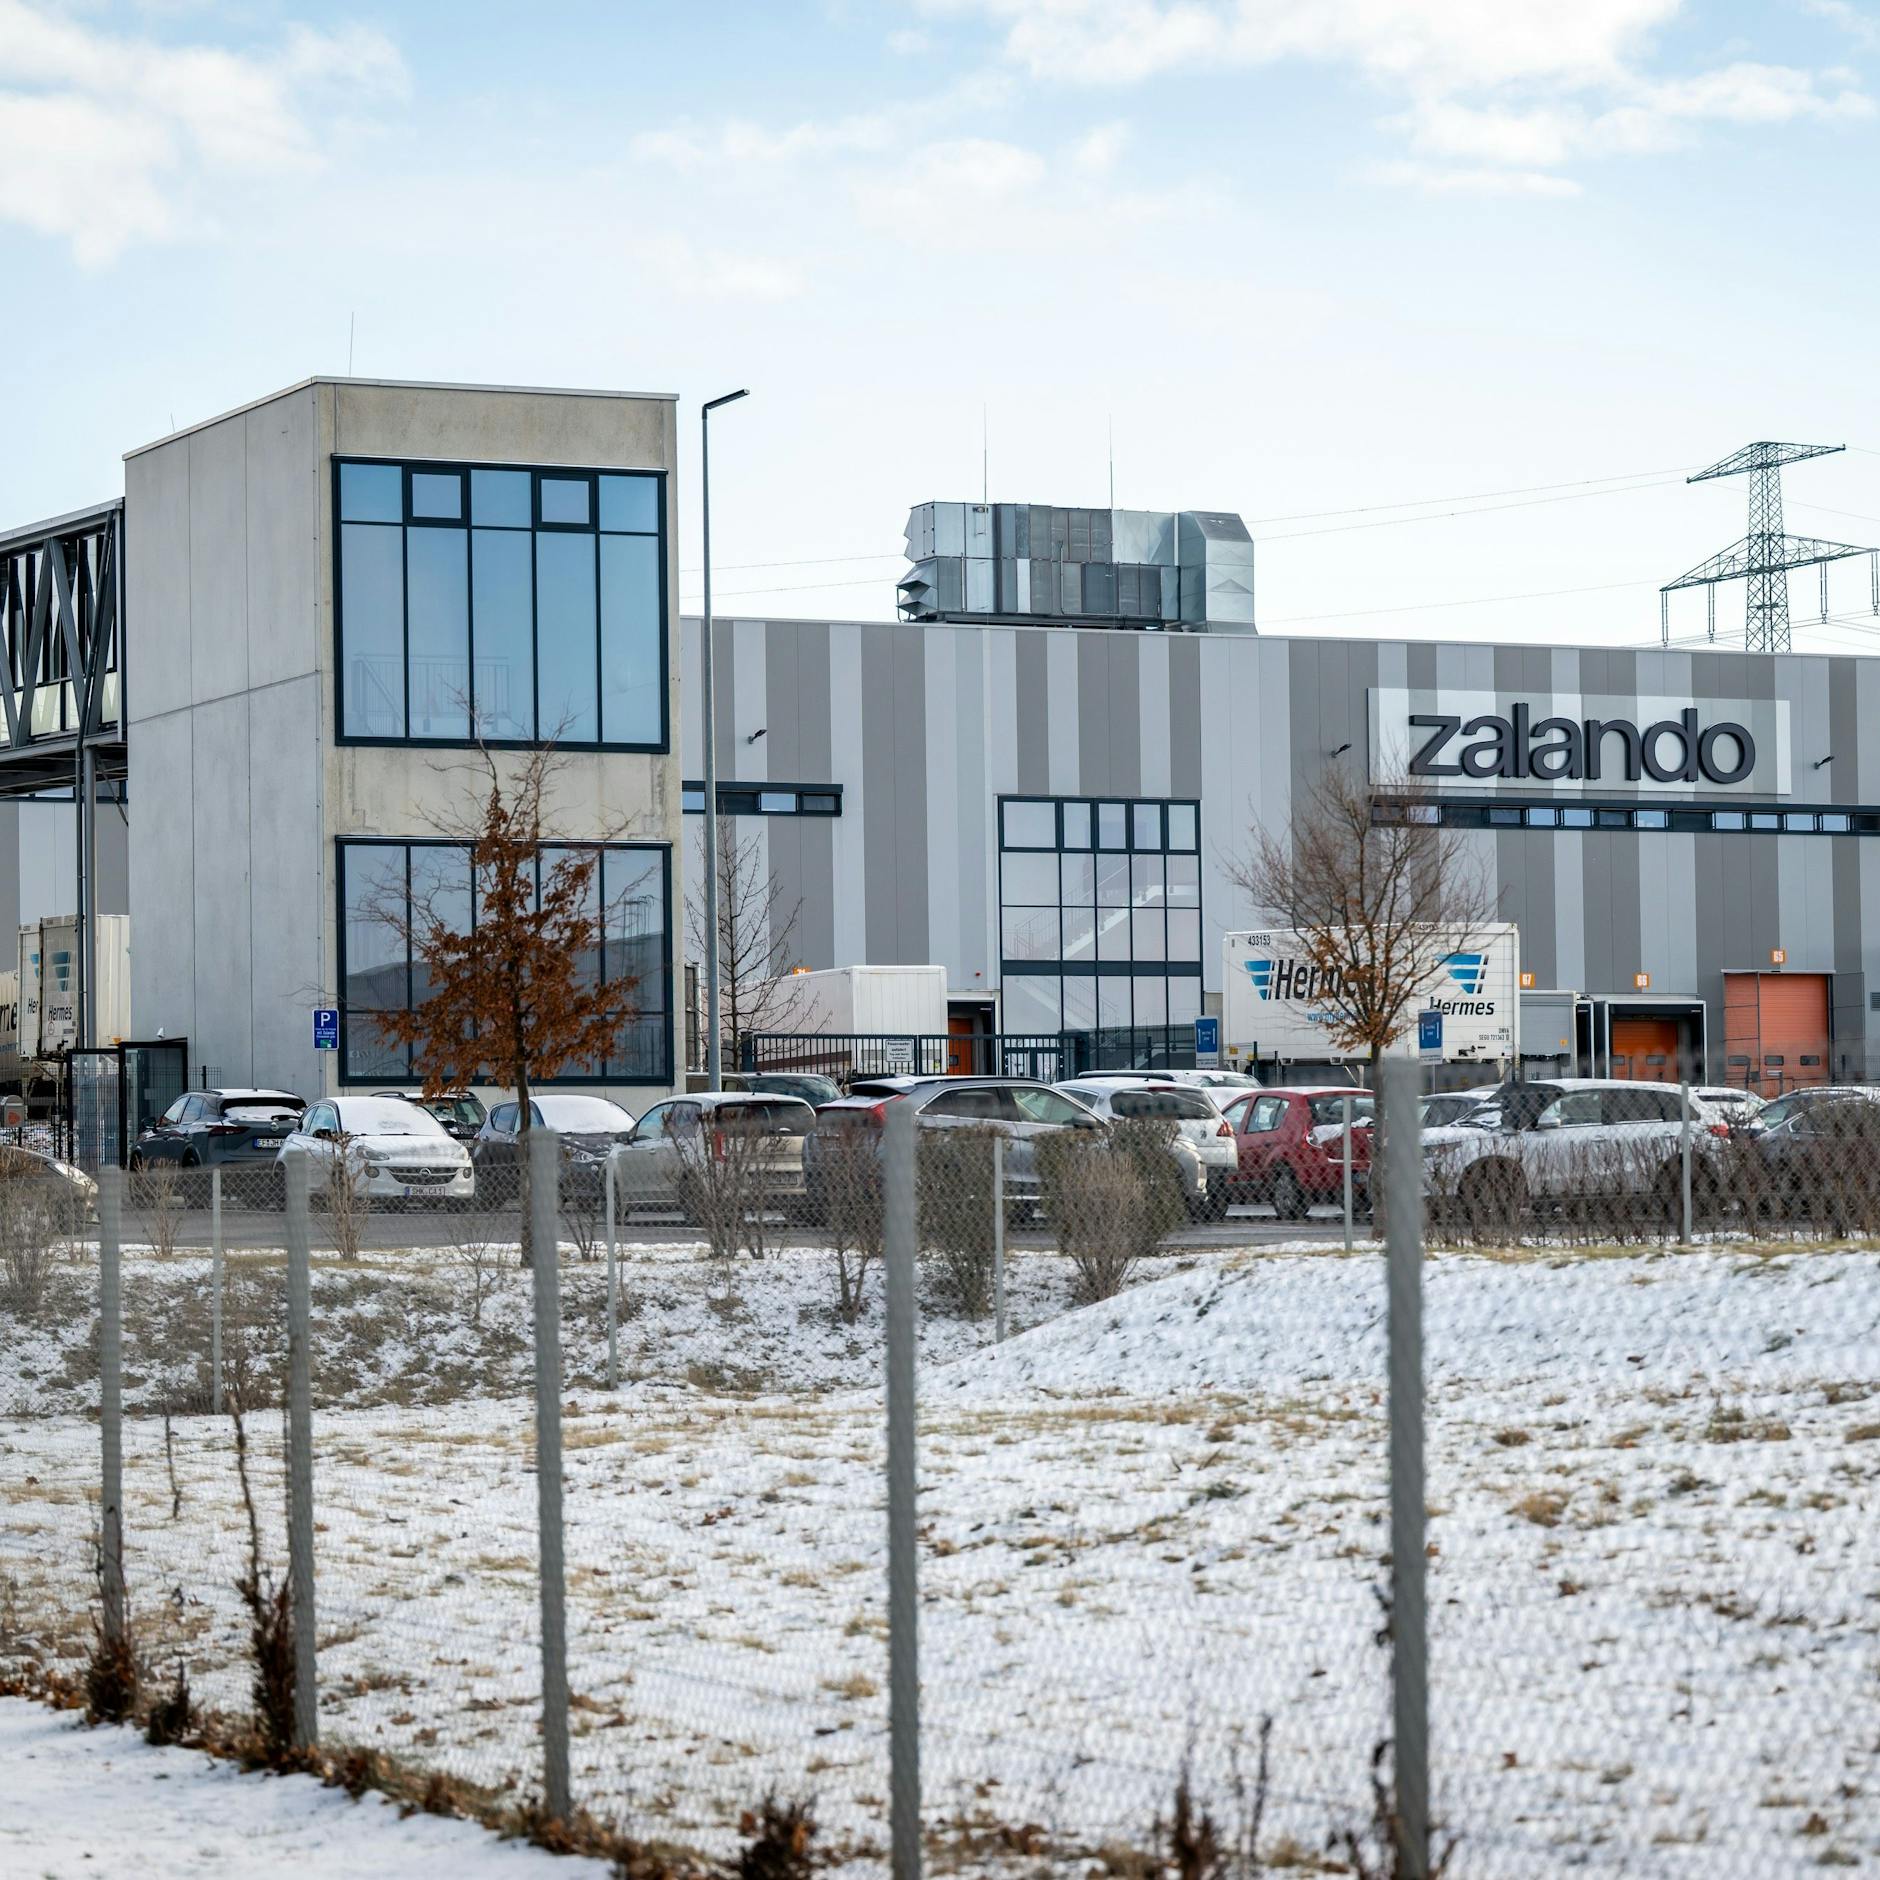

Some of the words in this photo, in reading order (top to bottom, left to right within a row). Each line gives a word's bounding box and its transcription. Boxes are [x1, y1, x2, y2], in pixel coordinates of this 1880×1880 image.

[1409, 702, 1756, 784] zalando
[1247, 934, 1271, 946] 433153
[48, 1004, 73, 1021] Hermes
[1429, 996, 1495, 1015] Hermes
[320, 1012, 331, 1027] P
